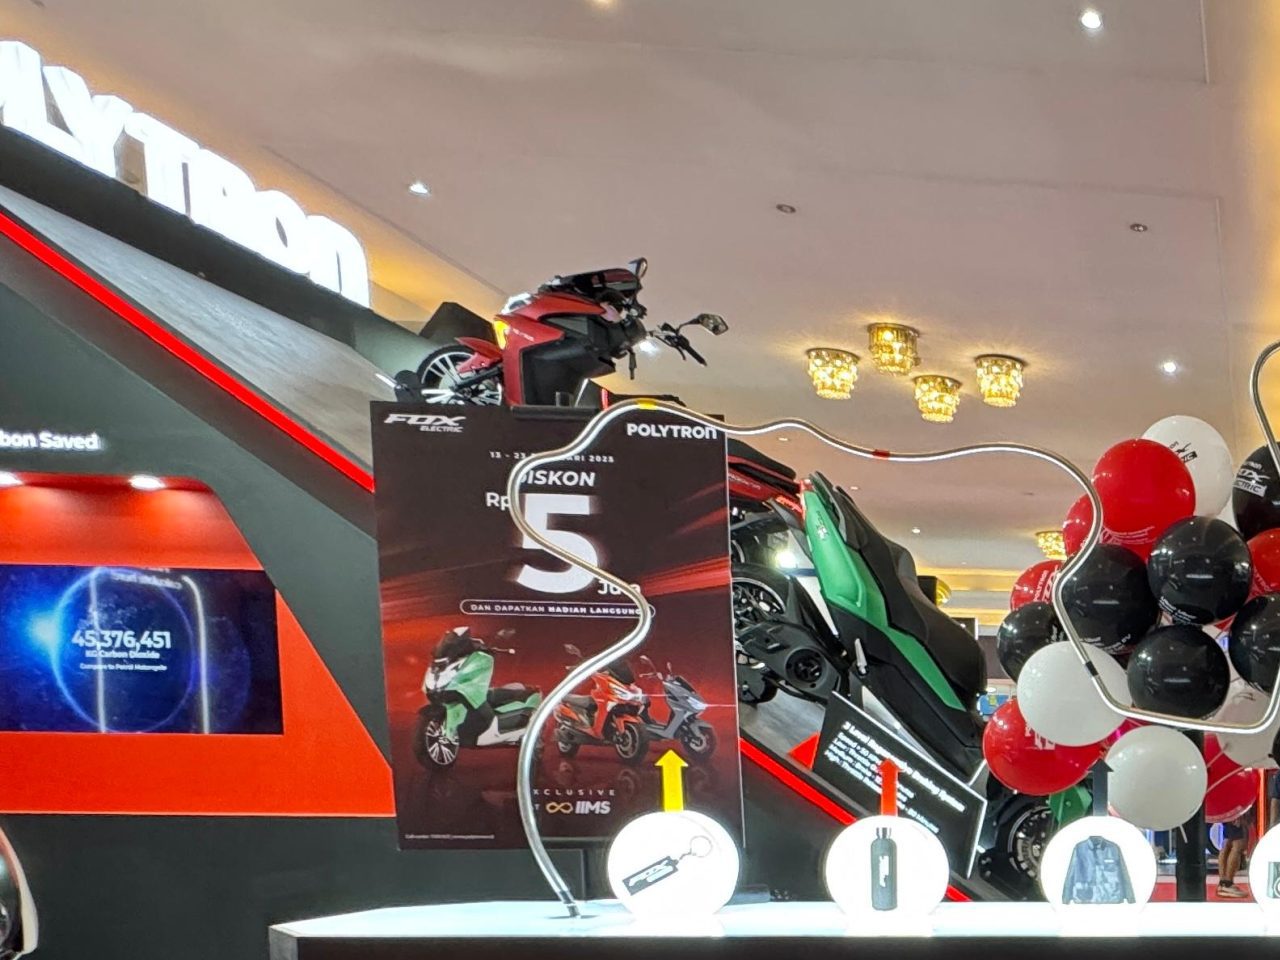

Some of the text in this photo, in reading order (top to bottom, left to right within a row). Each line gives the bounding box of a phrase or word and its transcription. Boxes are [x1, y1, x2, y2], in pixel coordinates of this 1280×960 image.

[384, 413, 467, 426] FOX
[420, 425, 464, 433] ELECTRIC
[626, 422, 718, 440] POLYTRON
[39, 429, 103, 451] Saved
[516, 493, 598, 593] 5
[533, 788, 615, 796] XCLUSIVE
